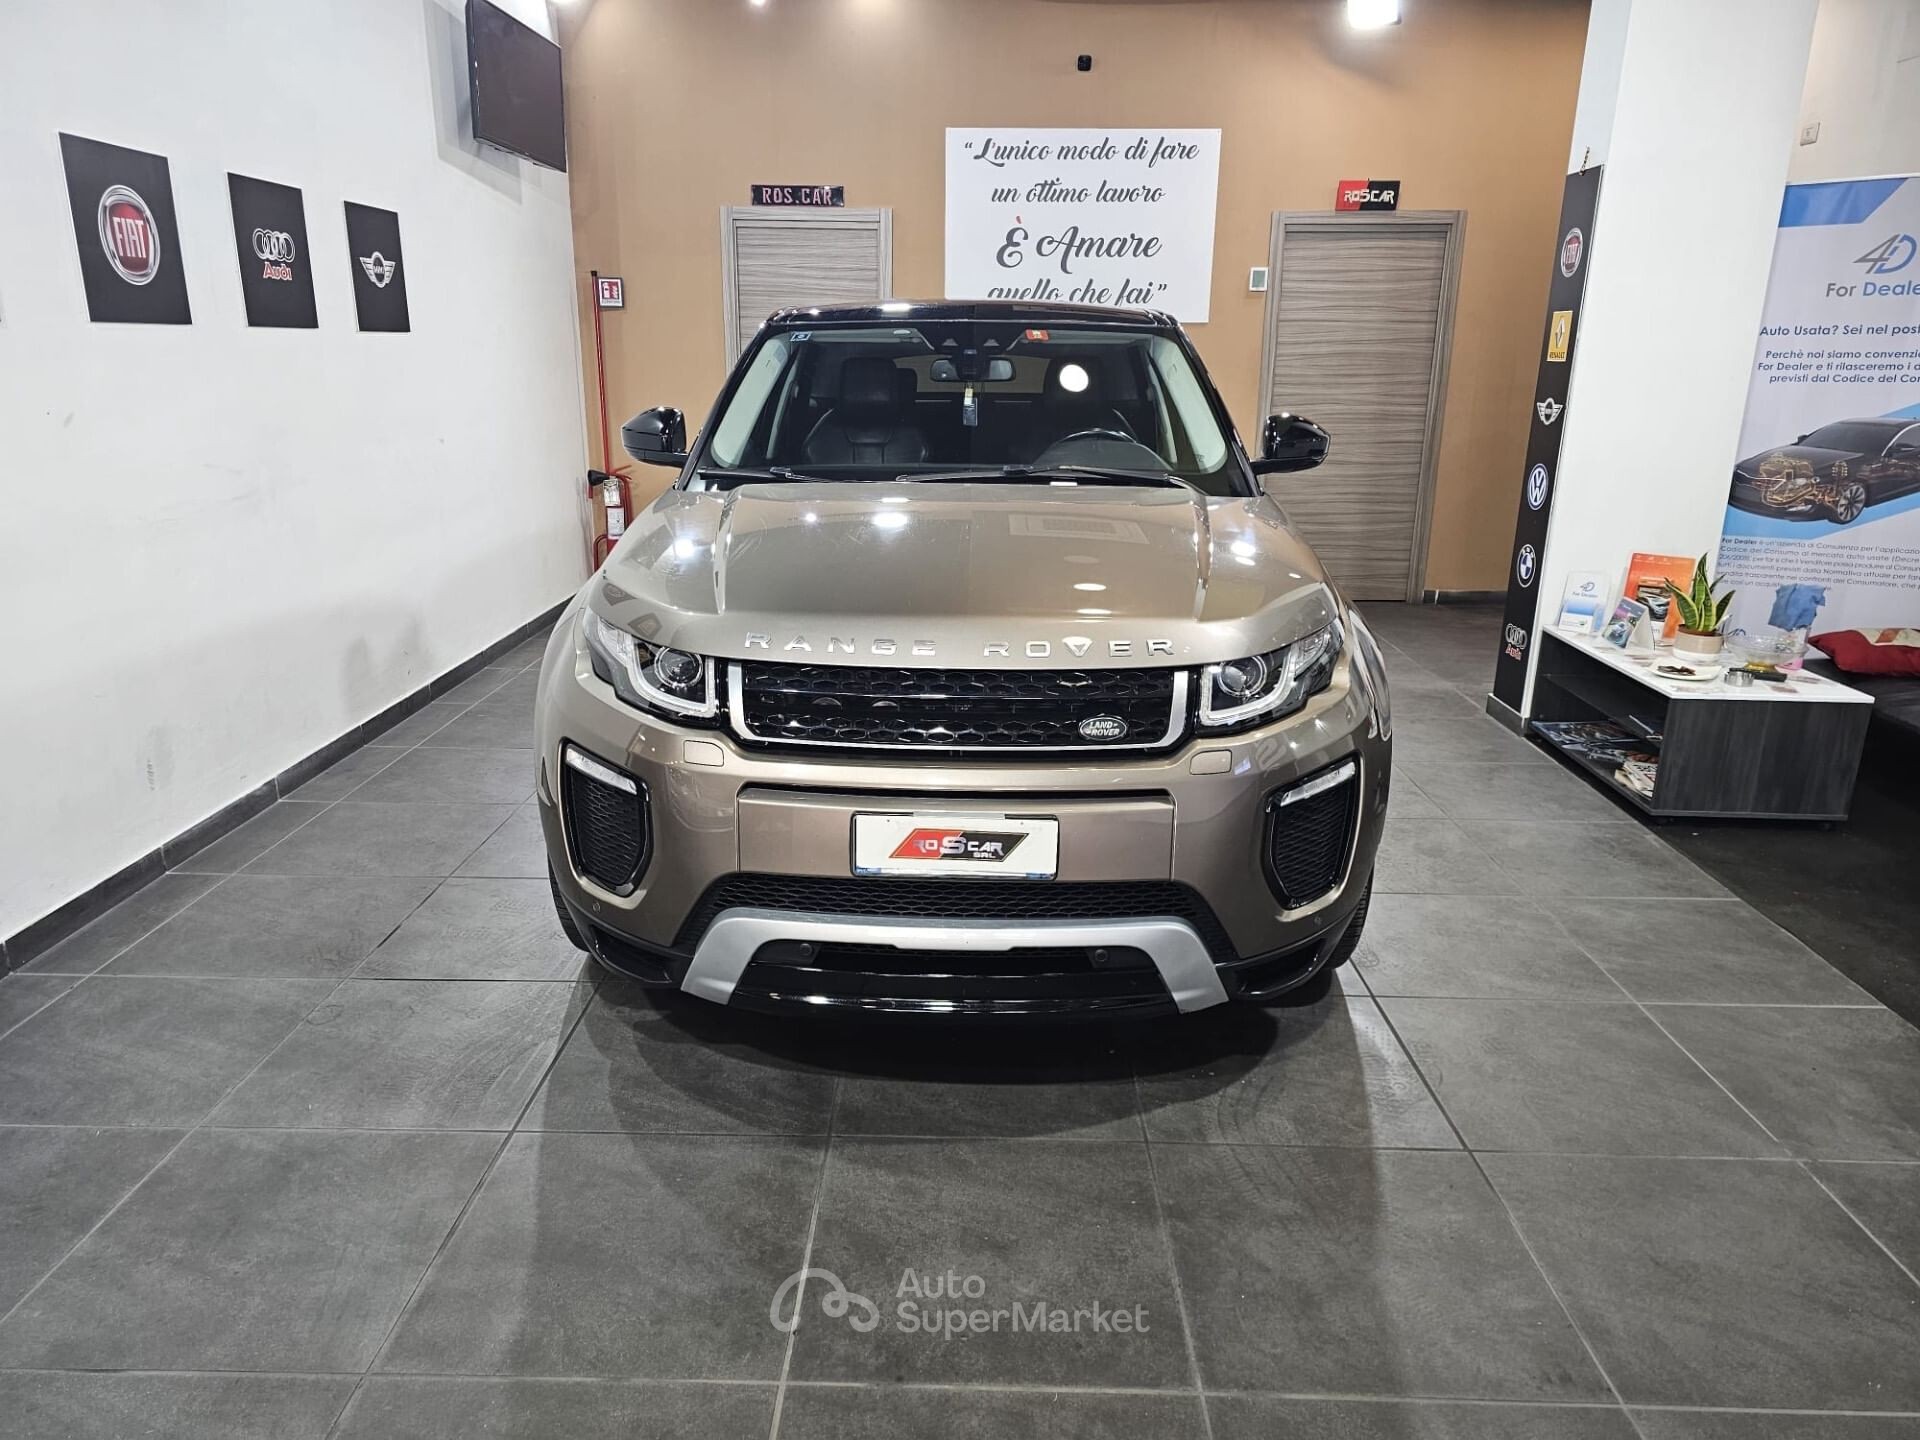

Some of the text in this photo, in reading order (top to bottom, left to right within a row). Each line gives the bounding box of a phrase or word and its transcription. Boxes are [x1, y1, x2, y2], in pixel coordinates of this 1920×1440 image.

[1057, 137, 1119, 160] modo
[1124, 137, 1148, 160] di
[1149, 136, 1200, 168] fare
[762, 187, 832, 206] ROS.CAR
[991, 177, 1166, 203] un ottimo lavoro
[112, 216, 147, 259] FIAT
[996, 215, 1163, 274] È Amare
[263, 261, 293, 281] Audi
[1069, 278, 1112, 304] che
[1826, 282, 1857, 297] For
[1759, 325, 1791, 337] Auto
[1794, 324, 1839, 336] Usata?
[1842, 323, 1863, 335] Sei
[1866, 323, 1888, 335] nel
[1807, 349, 1825, 359] noi
[1827, 349, 1862, 359] siamo
[1758, 362, 1774, 371] For
[1776, 361, 1813, 371] Dealer
[1816, 363, 1824, 371] e
[1826, 361, 1834, 371] ti
[1835, 361, 1904, 371] rilasceremo
[1907, 362, 1912, 371] i
[1769, 374, 1809, 384] previsti
[1811, 374, 1830, 383] dal
[1832, 374, 1875, 383] Codice
[1878, 374, 1897, 383] del
[743, 631, 1177, 658] RANGE ROVER
[1090, 728, 1120, 736] ROVER
